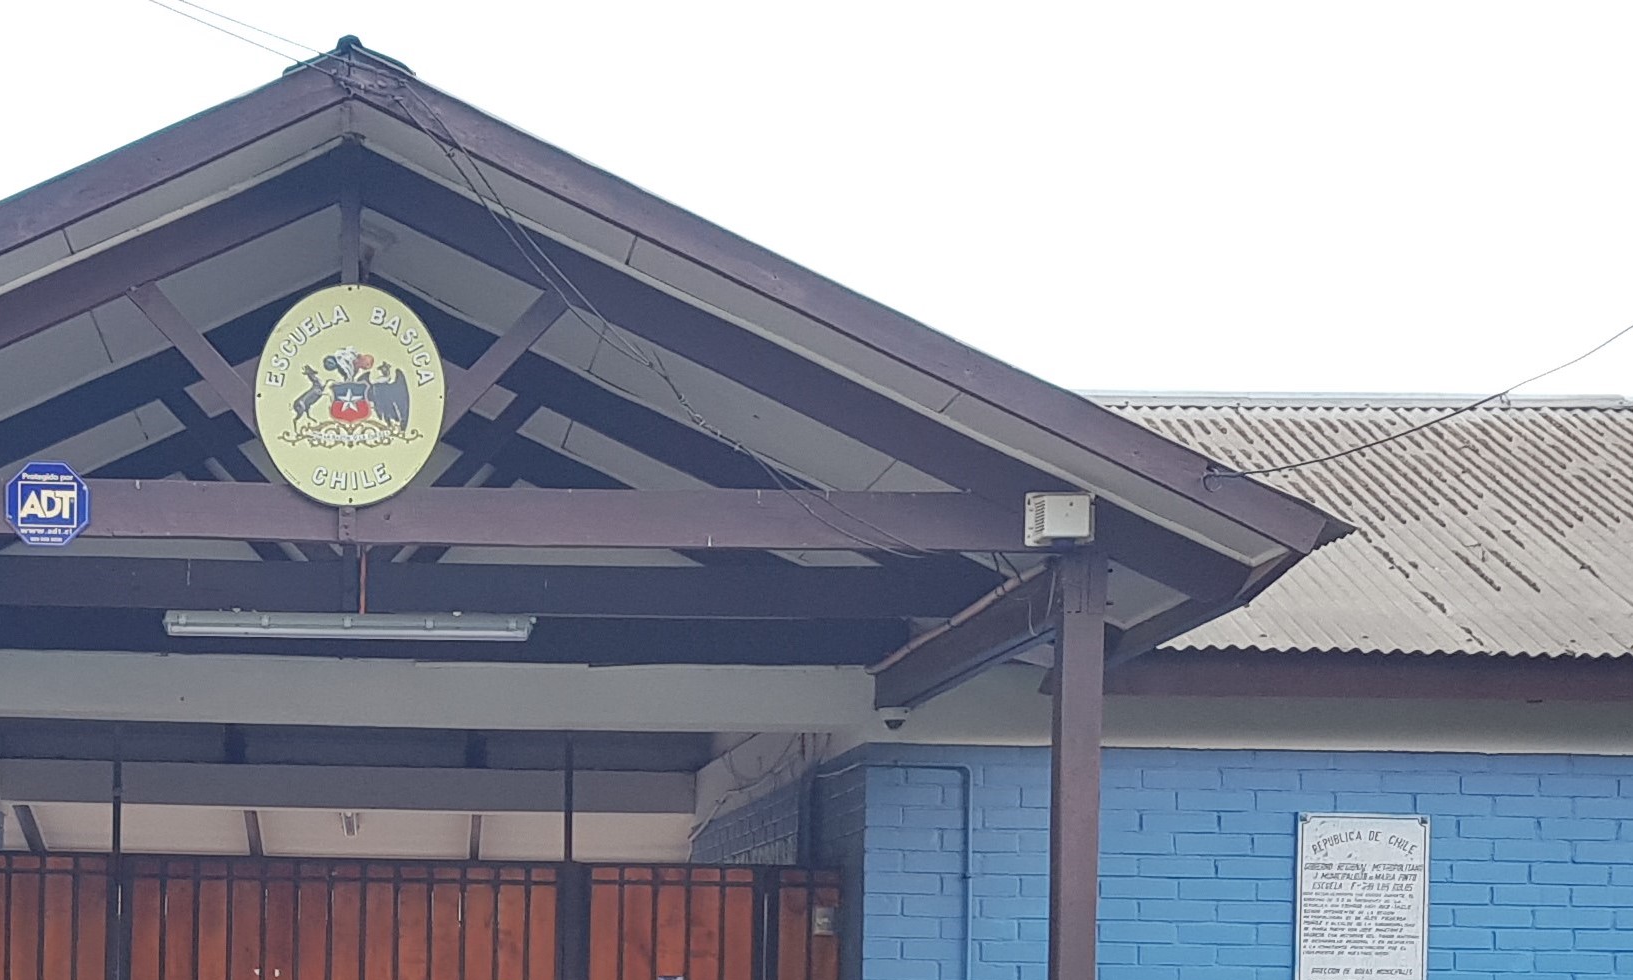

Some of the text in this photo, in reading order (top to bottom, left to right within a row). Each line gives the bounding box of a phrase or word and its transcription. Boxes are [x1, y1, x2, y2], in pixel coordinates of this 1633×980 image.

[266, 305, 435, 387] ESCUELA BASICA
[311, 463, 392, 490] CHILE
[21, 489, 75, 519] ADT
[1312, 830, 1418, 855] REPUBLICA DE CHILE
